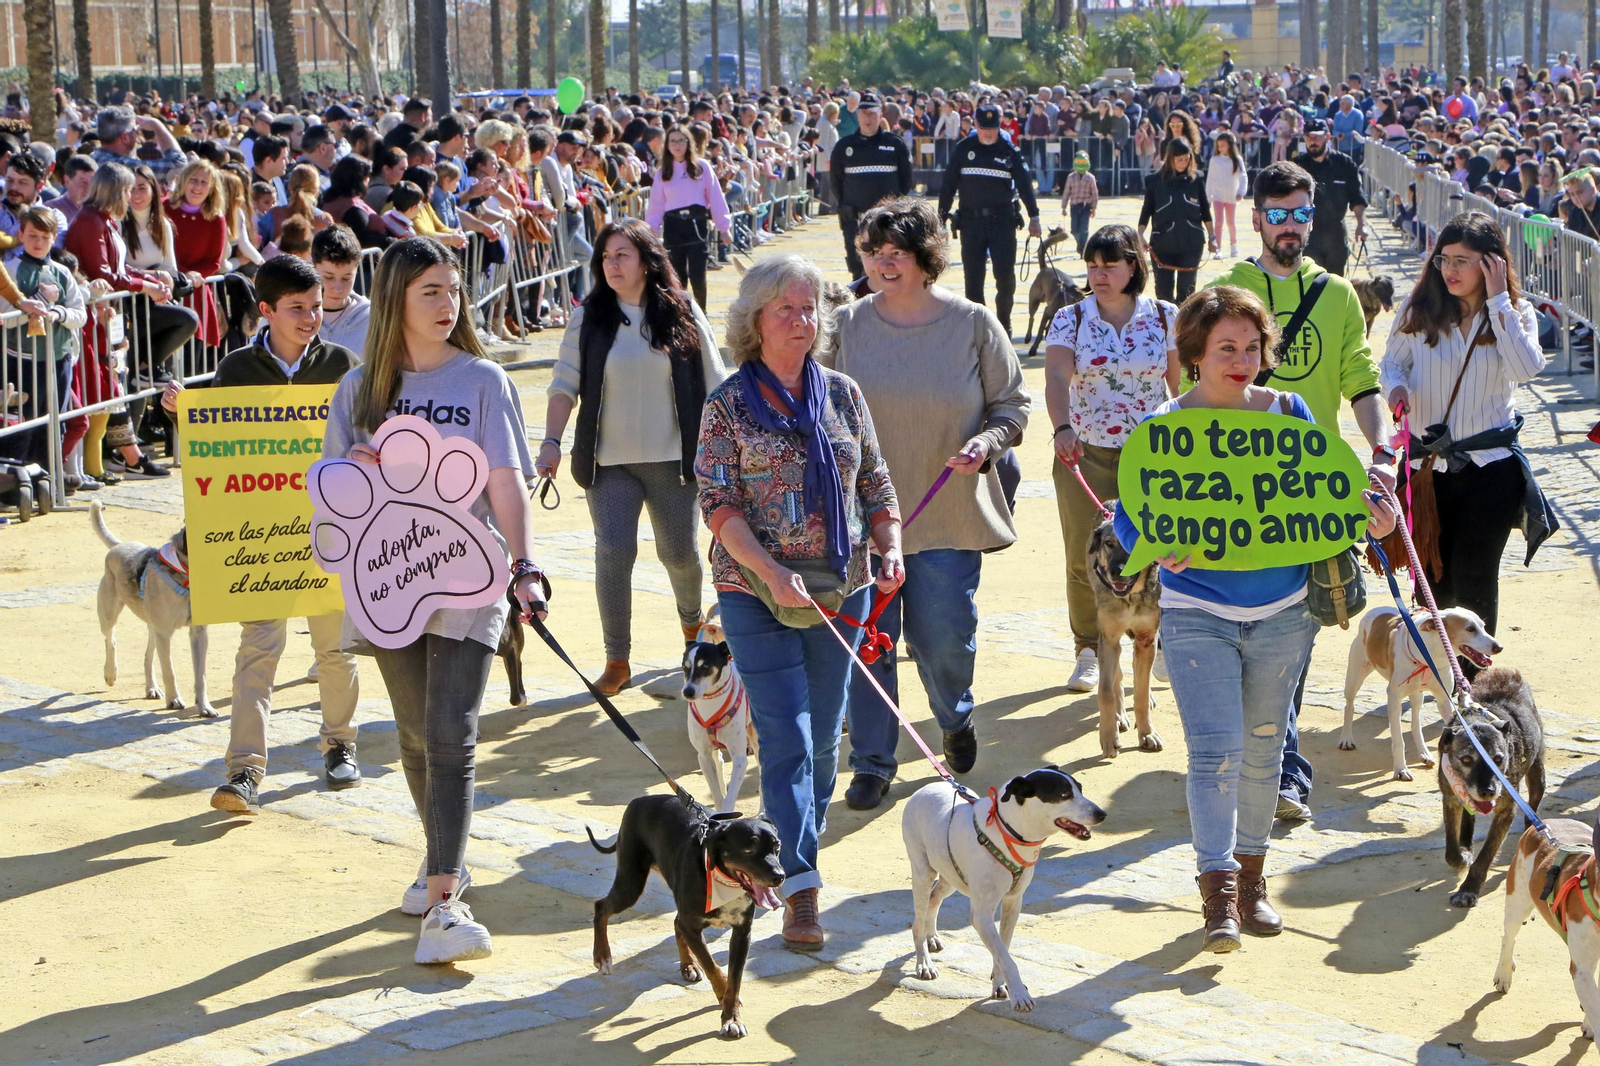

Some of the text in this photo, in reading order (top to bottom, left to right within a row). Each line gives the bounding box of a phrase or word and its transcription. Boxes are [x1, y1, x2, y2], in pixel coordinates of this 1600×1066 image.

[1149, 419, 1327, 469] no tengo
[195, 477, 213, 496] Y
[1140, 467, 1350, 513] raza, pero
[204, 530, 235, 544] son
[239, 521, 264, 541] las
[367, 518, 440, 572] adopta,
[1138, 502, 1366, 561] tengo amor
[224, 546, 270, 566] clave
[370, 539, 468, 602] no compres
[229, 571, 329, 593] el abandono
